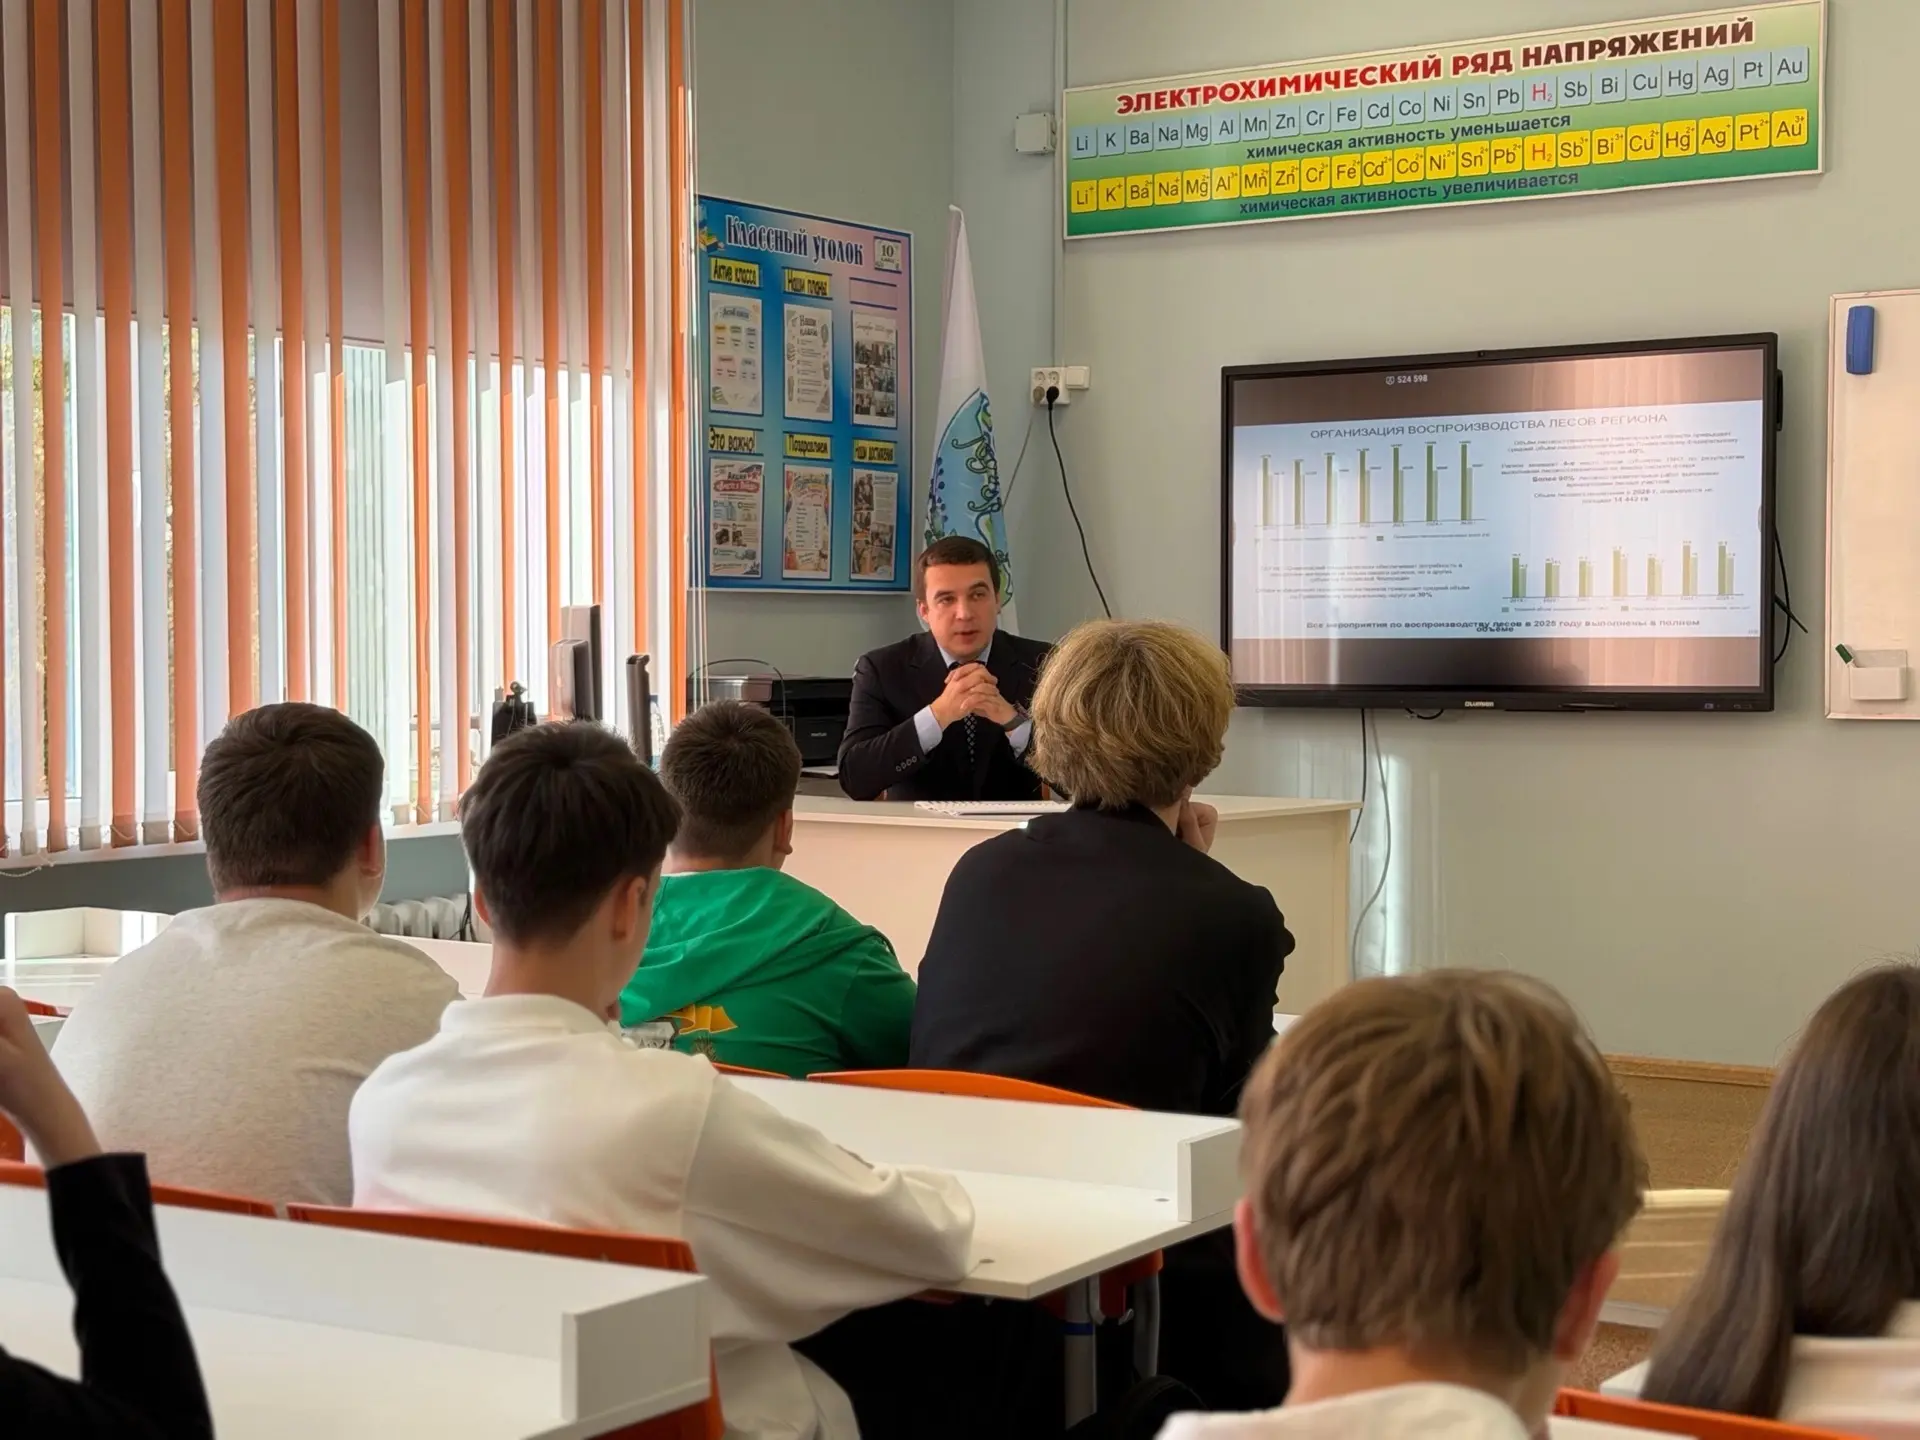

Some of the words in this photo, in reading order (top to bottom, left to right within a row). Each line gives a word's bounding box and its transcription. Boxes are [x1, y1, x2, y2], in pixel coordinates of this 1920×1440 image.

[1117, 54, 1442, 115] ЭЛЕКТРОХИМИЧЕСКИЙ
[1452, 49, 1513, 77] РЯД
[1522, 16, 1754, 68] НАПРЯЖЕНИЙ
[1077, 136, 1088, 150] Li
[1106, 132, 1116, 147] K
[1131, 130, 1149, 145] Ba
[1159, 127, 1178, 142] Na
[1187, 123, 1208, 141] Mg
[1219, 119, 1233, 135] Al
[1245, 117, 1267, 133] Mn
[1276, 114, 1295, 129] Zn
[1306, 111, 1324, 126] Cr
[1337, 107, 1356, 122] Fe
[1368, 102, 1389, 119] Cd
[1399, 100, 1421, 116] Co
[1434, 95, 1450, 112] Ni
[1463, 93, 1485, 109] Sn
[1498, 89, 1519, 105] Pb
[1564, 81, 1587, 98] Sb
[1602, 77, 1618, 94] Bi
[1633, 74, 1657, 90] Cu
[1669, 69, 1692, 89] Hg
[1704, 66, 1728, 86] Ag
[1744, 62, 1763, 79] Pt
[1777, 58, 1802, 75] Au
[1247, 139, 1342, 159] химическая
[1348, 127, 1445, 148] активность
[1451, 115, 1570, 141] уменьшается
[1240, 195, 1335, 213] химическая
[1341, 185, 1437, 206] активность
[1443, 173, 1578, 199] увеличивается
[727, 216, 808, 256] Классный
[813, 235, 863, 265] уголок
[881, 245, 894, 257] 10
[714, 258, 732, 282] Актив
[735, 267, 757, 285] класса
[787, 269, 804, 292] Наши
[1413, 374, 1428, 383] 598
[710, 427, 725, 449] Это
[1310, 426, 1405, 439] ОРГАНИЗАЦИЯ
[1408, 419, 1546, 435] ВОСПРОИЗВОДСТВА
[1549, 416, 1597, 428] ЛЕСОВ
[1601, 413, 1668, 425] РЕГИОНА
[1404, 620, 1490, 630] воспроизводству
[1559, 620, 1581, 629] году
